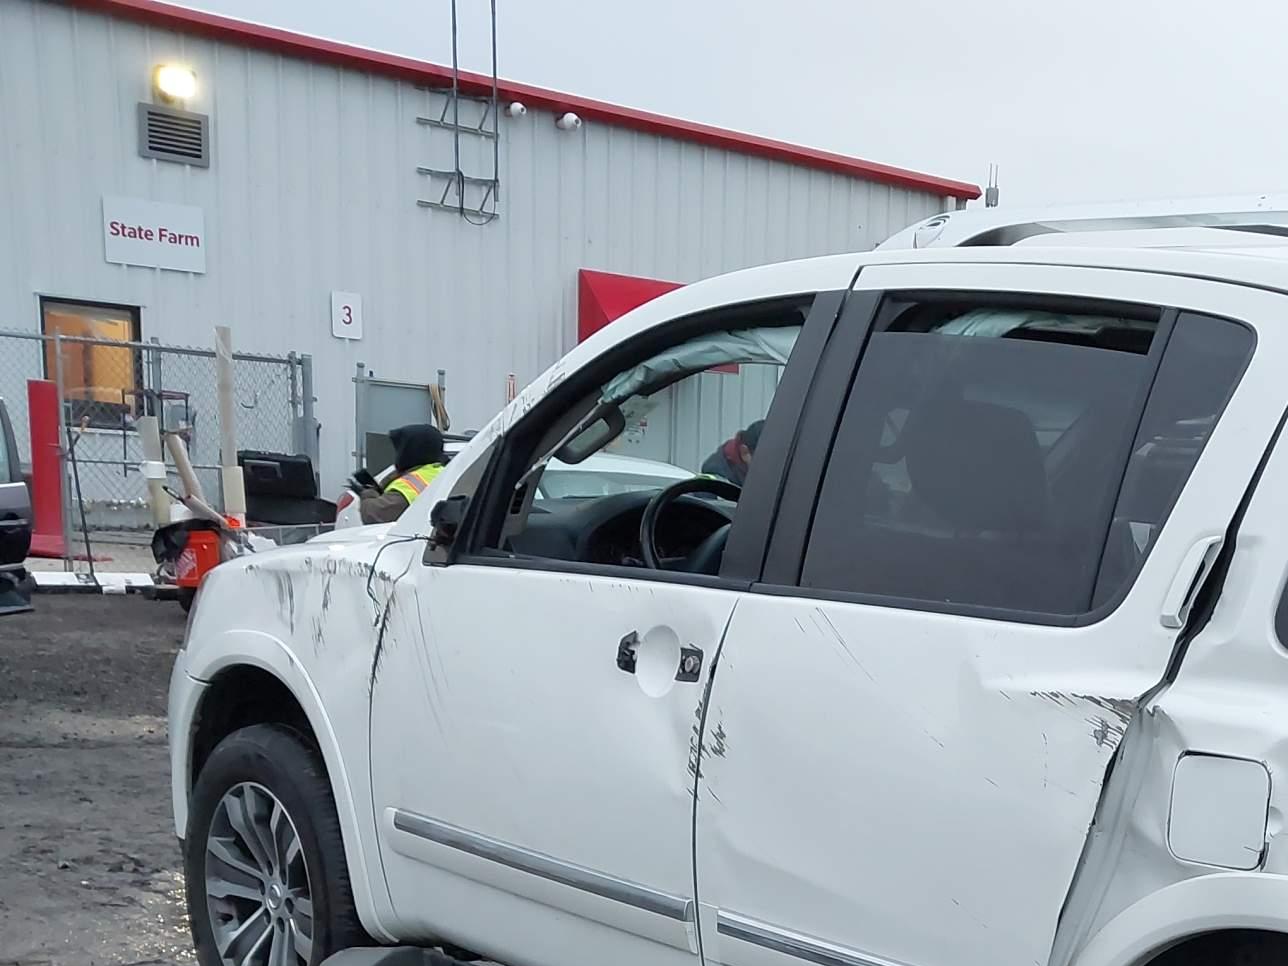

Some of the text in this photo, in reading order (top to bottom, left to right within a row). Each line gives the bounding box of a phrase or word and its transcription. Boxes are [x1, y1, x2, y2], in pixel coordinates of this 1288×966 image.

[109, 220, 200, 248] State Farm
[342, 305, 353, 325] 3
